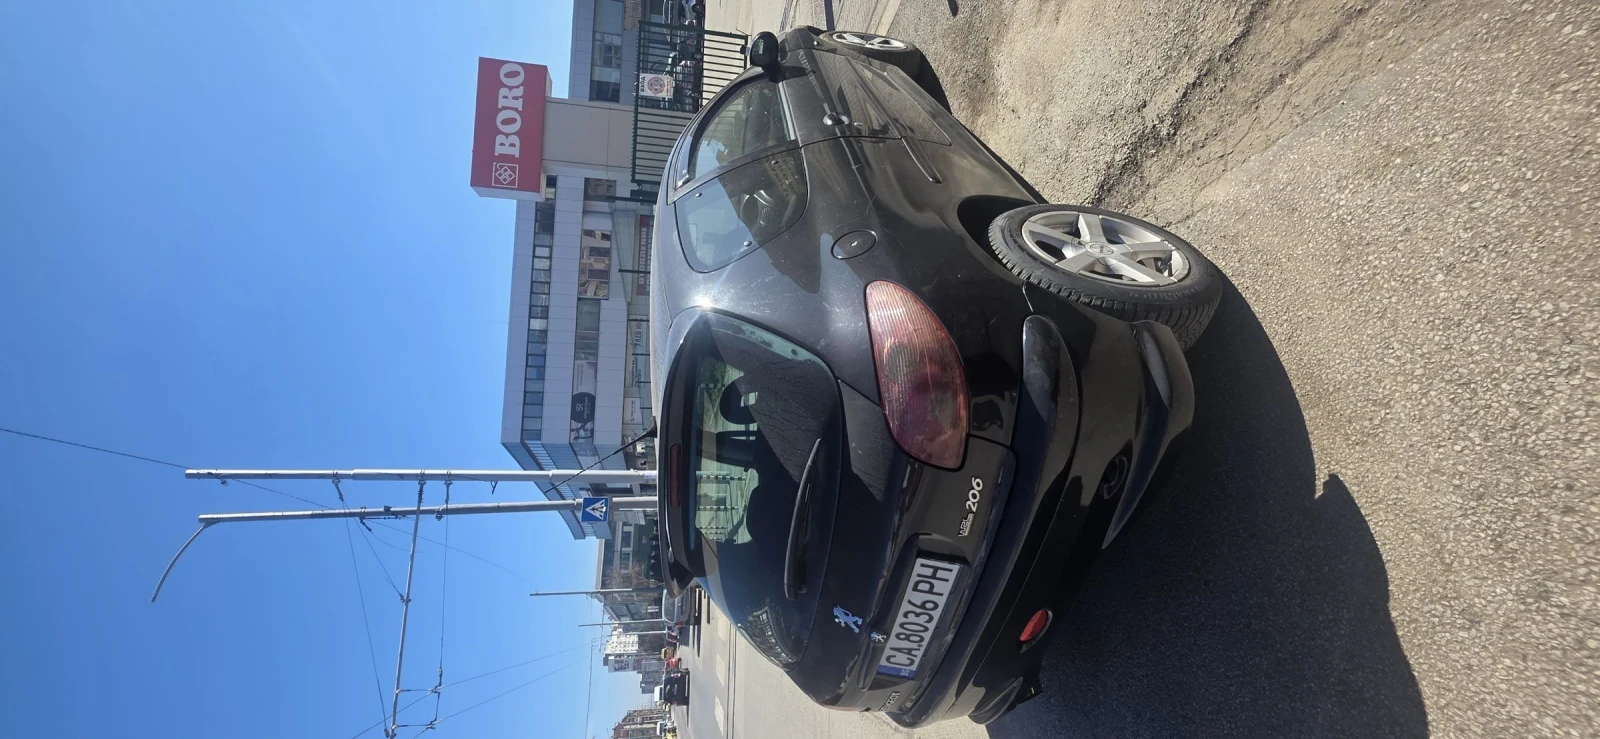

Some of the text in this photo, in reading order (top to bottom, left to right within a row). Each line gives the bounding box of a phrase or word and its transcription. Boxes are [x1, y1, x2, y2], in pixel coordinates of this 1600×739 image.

[495, 63, 525, 157] BORO
[638, 226, 647, 285] ОТОПЛЕНИЕ
[965, 477, 983, 513] 206
